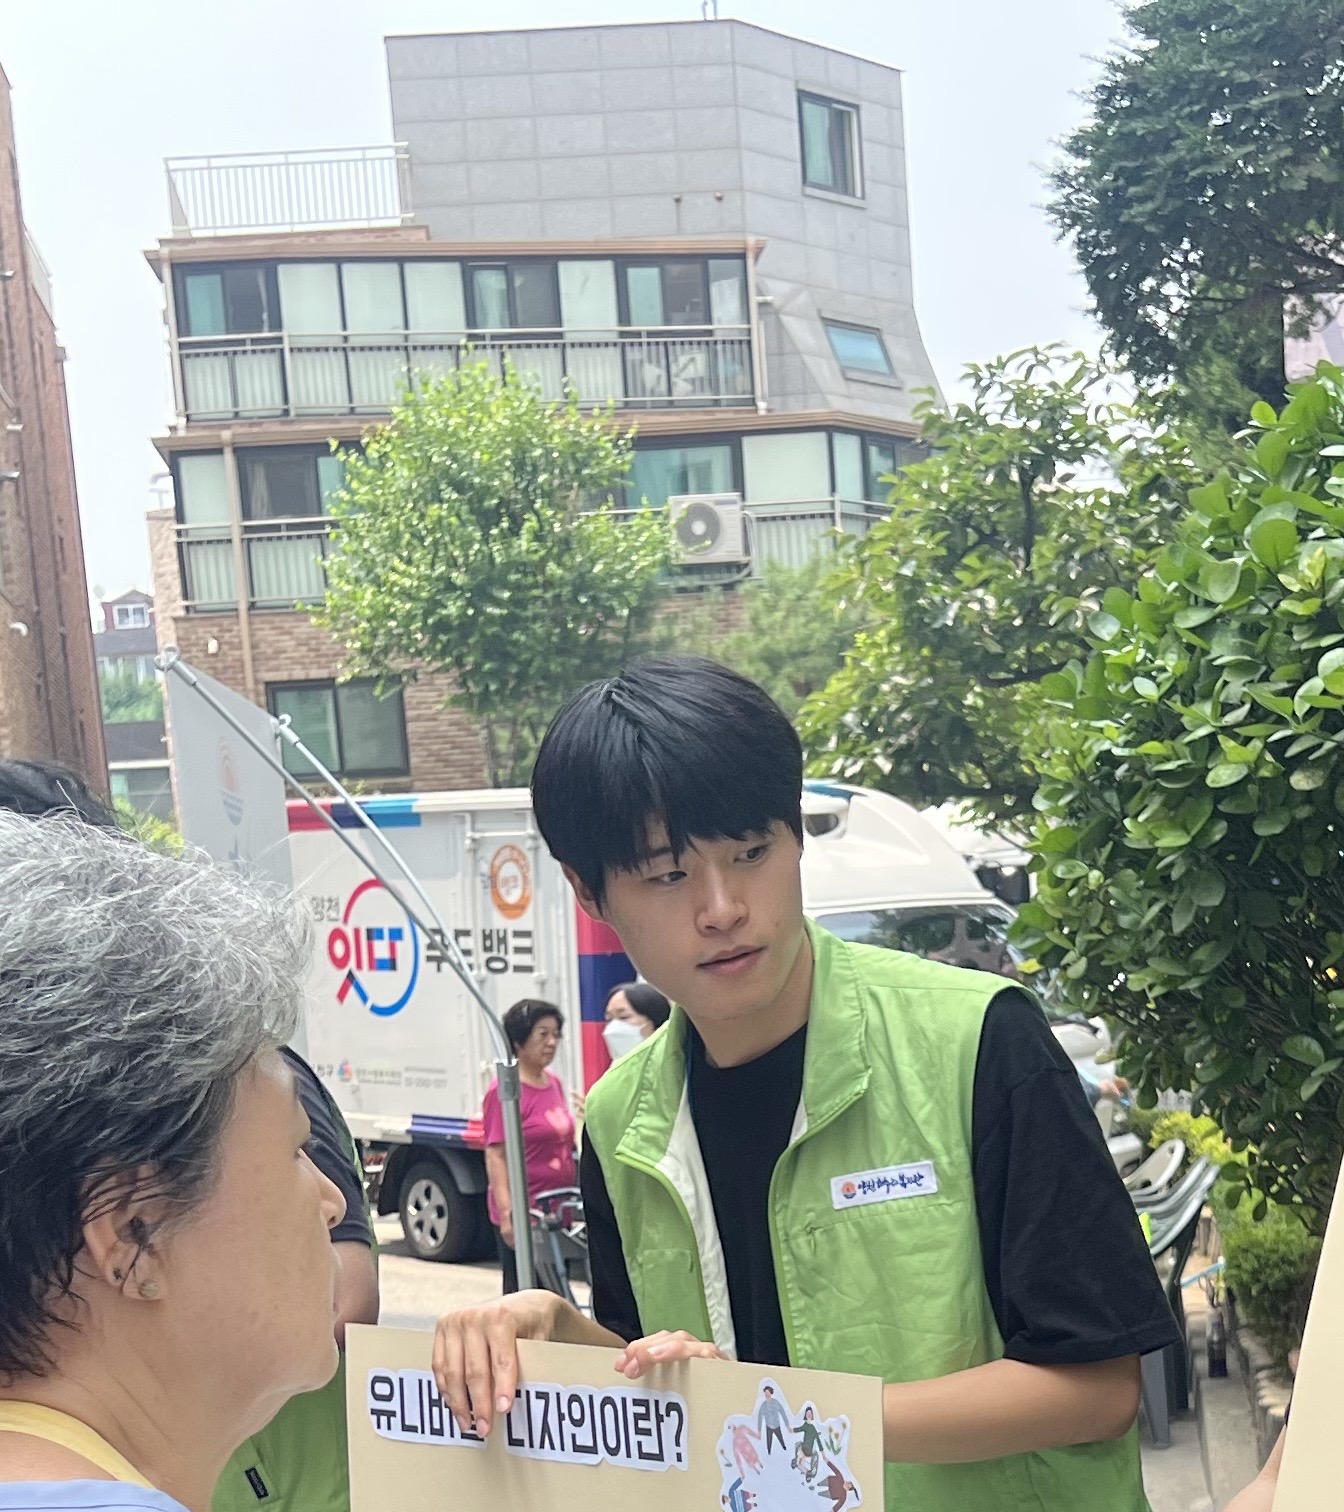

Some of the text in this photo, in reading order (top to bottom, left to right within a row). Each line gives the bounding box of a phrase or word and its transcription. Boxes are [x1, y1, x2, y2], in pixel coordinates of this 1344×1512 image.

[426, 928, 535, 975] 푸드뱅크
[370, 1374, 684, 1463] 유니버 디자인이란?
